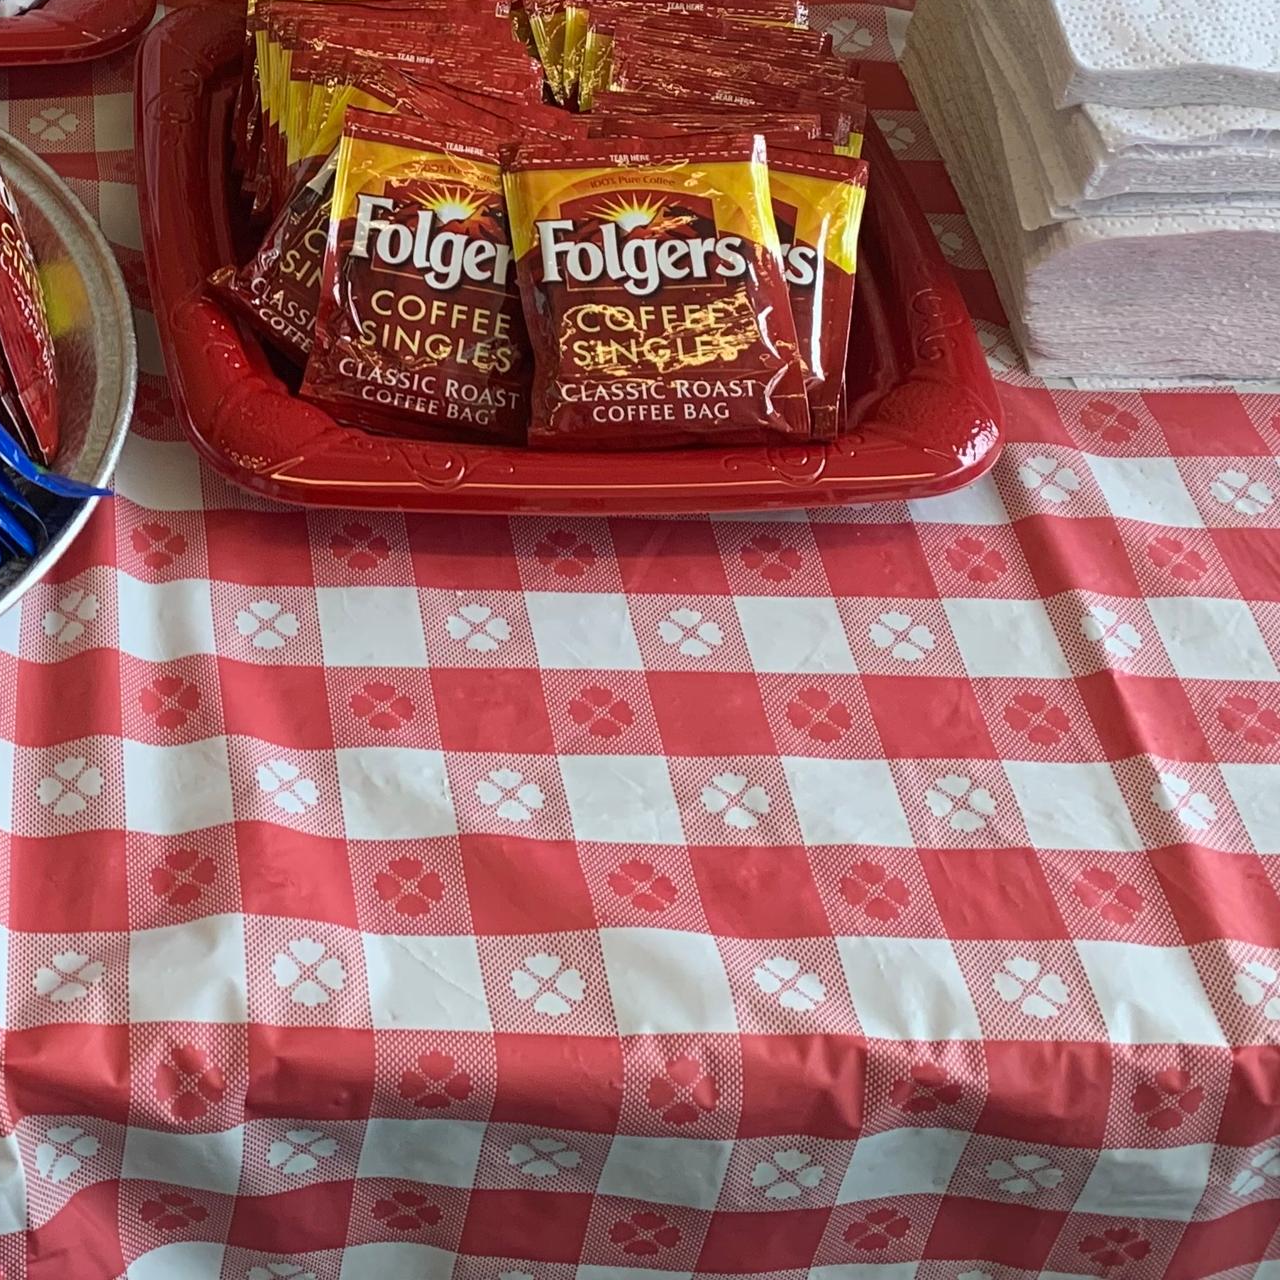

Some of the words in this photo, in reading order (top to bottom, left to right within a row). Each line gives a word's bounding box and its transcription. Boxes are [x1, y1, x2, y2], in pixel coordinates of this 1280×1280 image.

[398, 53, 415, 61] TEAR
[417, 57, 435, 65] HERE
[446, 142, 463, 152] TEAR
[465, 145, 484, 156] HERE
[609, 154, 626, 163] TEAR
[590, 178, 616, 188] 100%
[618, 176, 640, 185] Pure
[643, 177, 676, 186] Coffee
[349, 194, 513, 290] Folger
[536, 220, 746, 295] Folgers
[251, 277, 316, 331] CLASSI
[371, 290, 511, 339] COFFEE
[577, 304, 725, 332] COFFEE
[259, 308, 313, 353] COFFE
[359, 321, 512, 372] SINGLES
[574, 336, 737, 366] SINGLES
[339, 358, 436, 394] CLASSIC
[445, 379, 520, 409] ROAST
[561, 383, 665, 402] CLASSIC
[677, 380, 756, 398] ROAST
[362, 385, 438, 415] COFFEE
[446, 403, 489, 425] BAG
[593, 404, 674, 422] COFFEE
[685, 403, 729, 420] BAG
